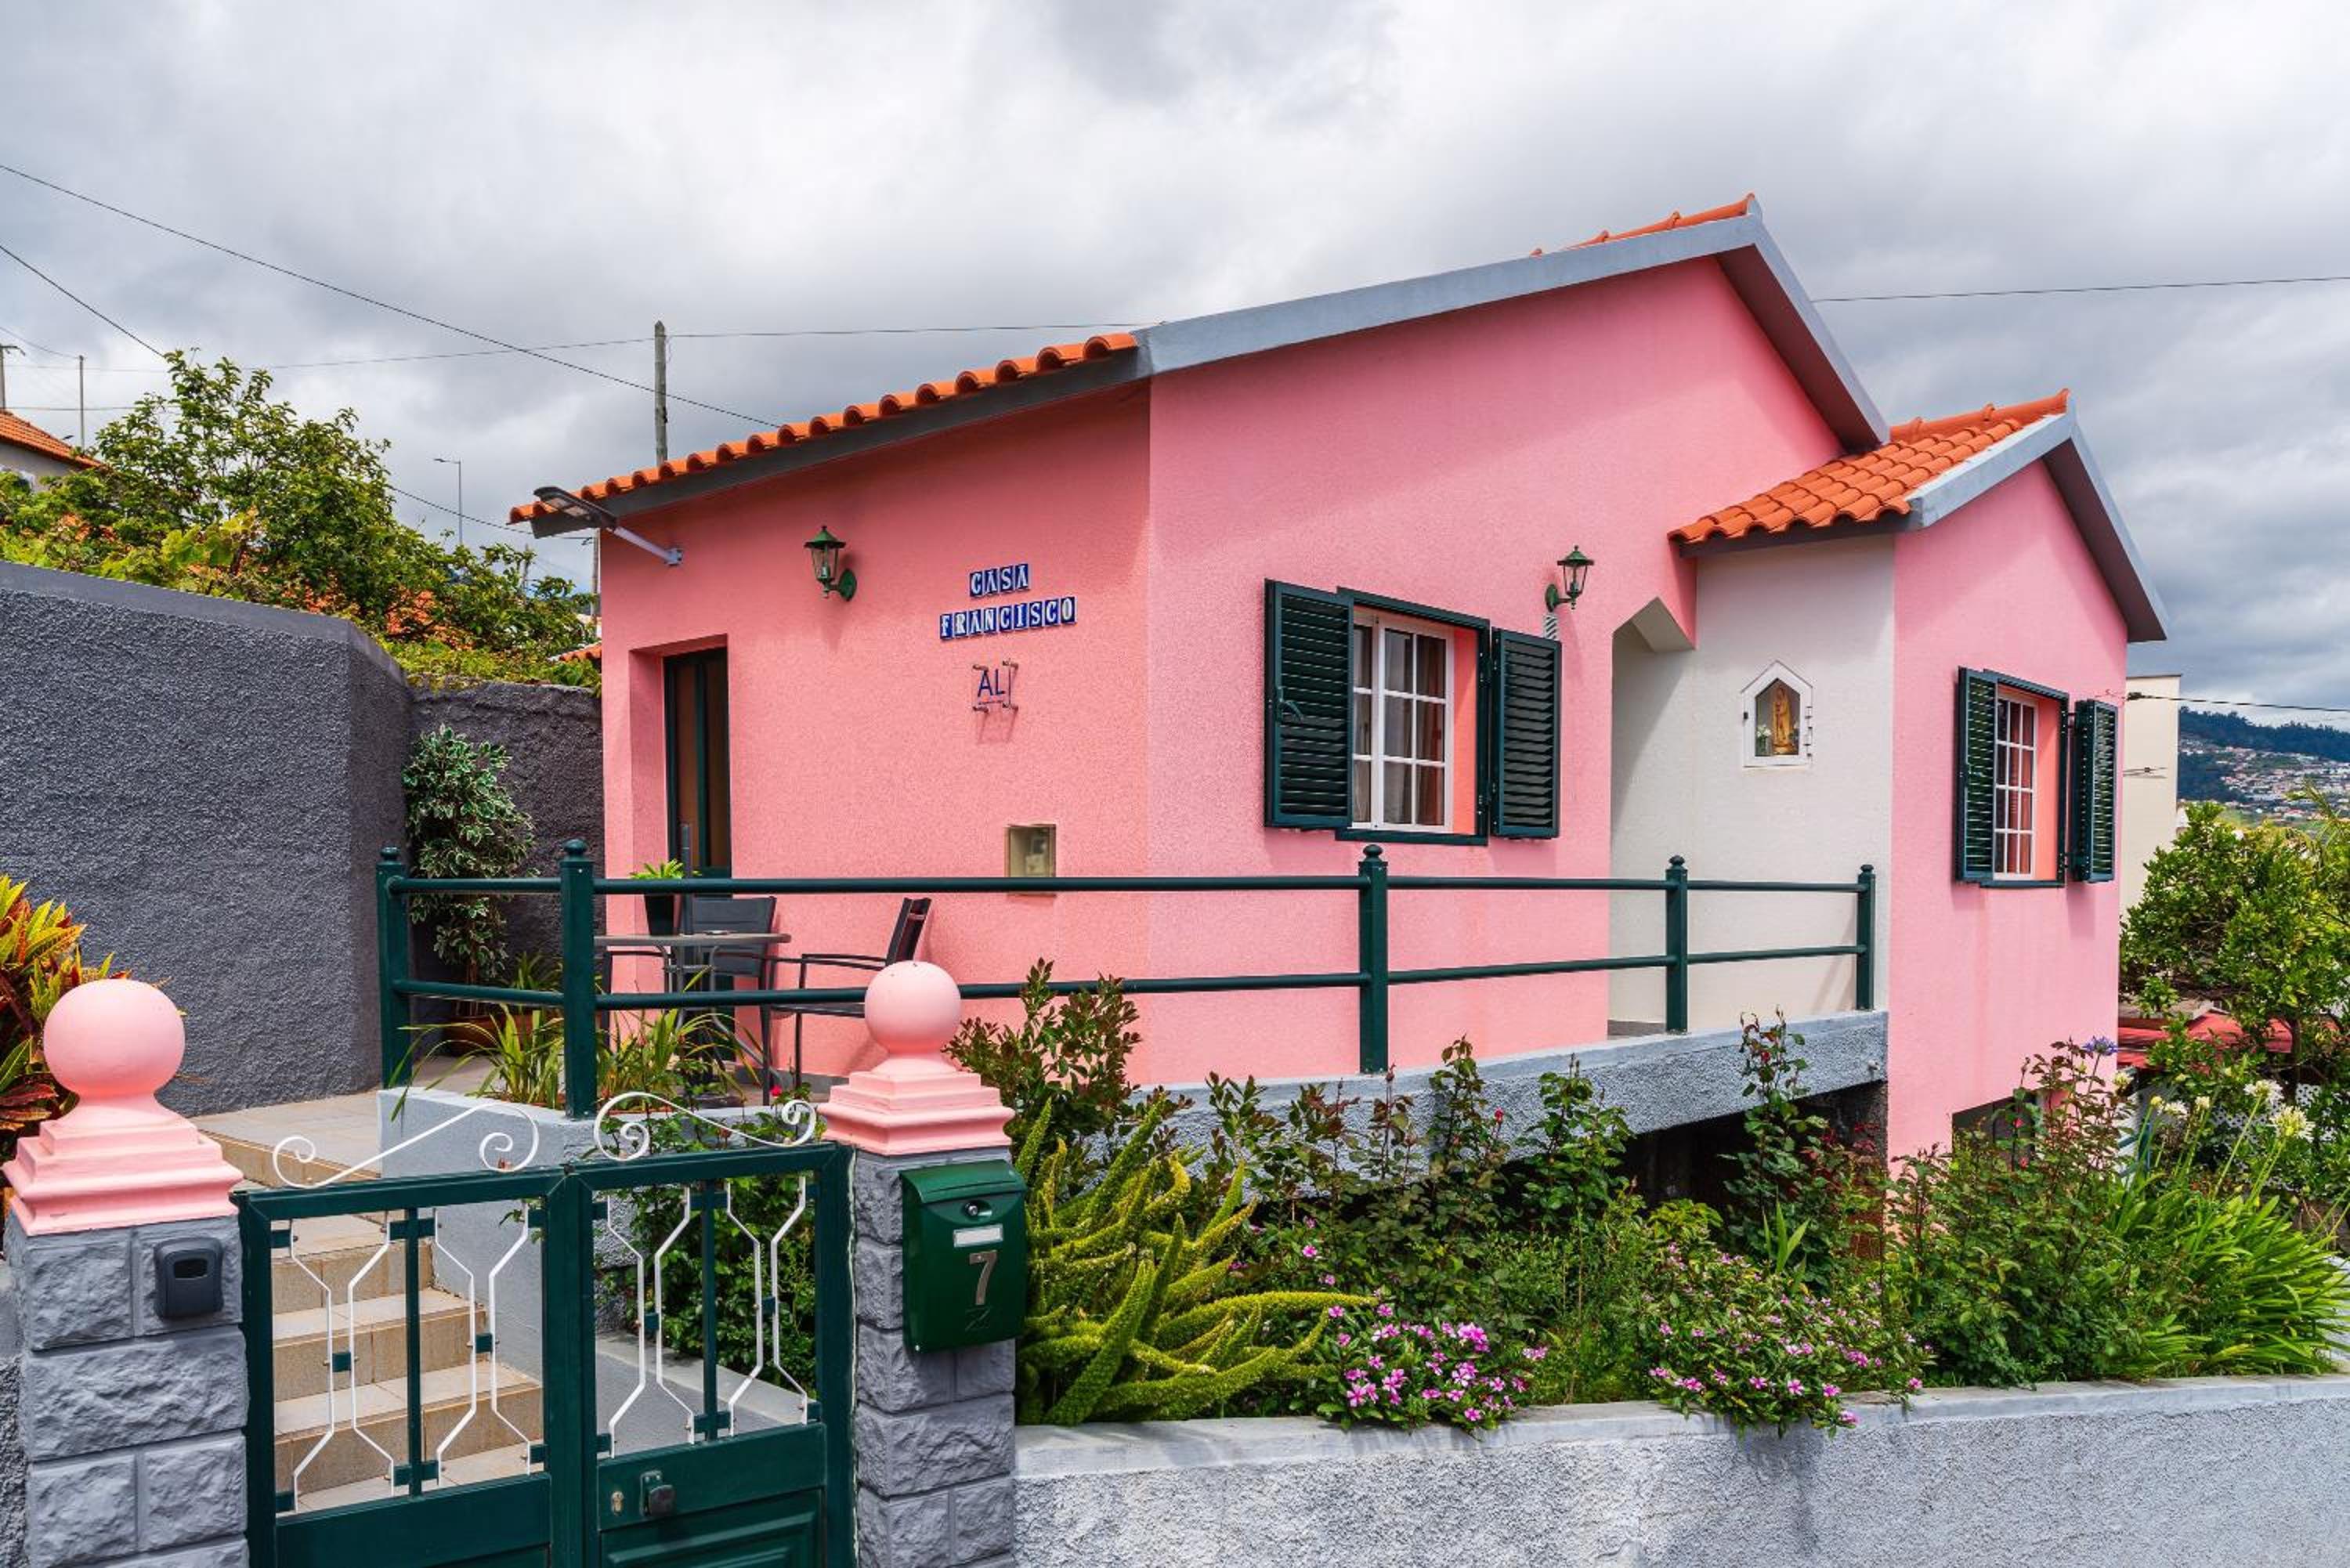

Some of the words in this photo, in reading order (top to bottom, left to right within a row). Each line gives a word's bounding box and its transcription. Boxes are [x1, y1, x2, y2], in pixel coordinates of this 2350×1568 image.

[971, 565, 1028, 595] CASA
[942, 598, 1073, 638] FRANCISCO
[978, 668, 1005, 697] AL
[969, 1249, 998, 1306] 7
